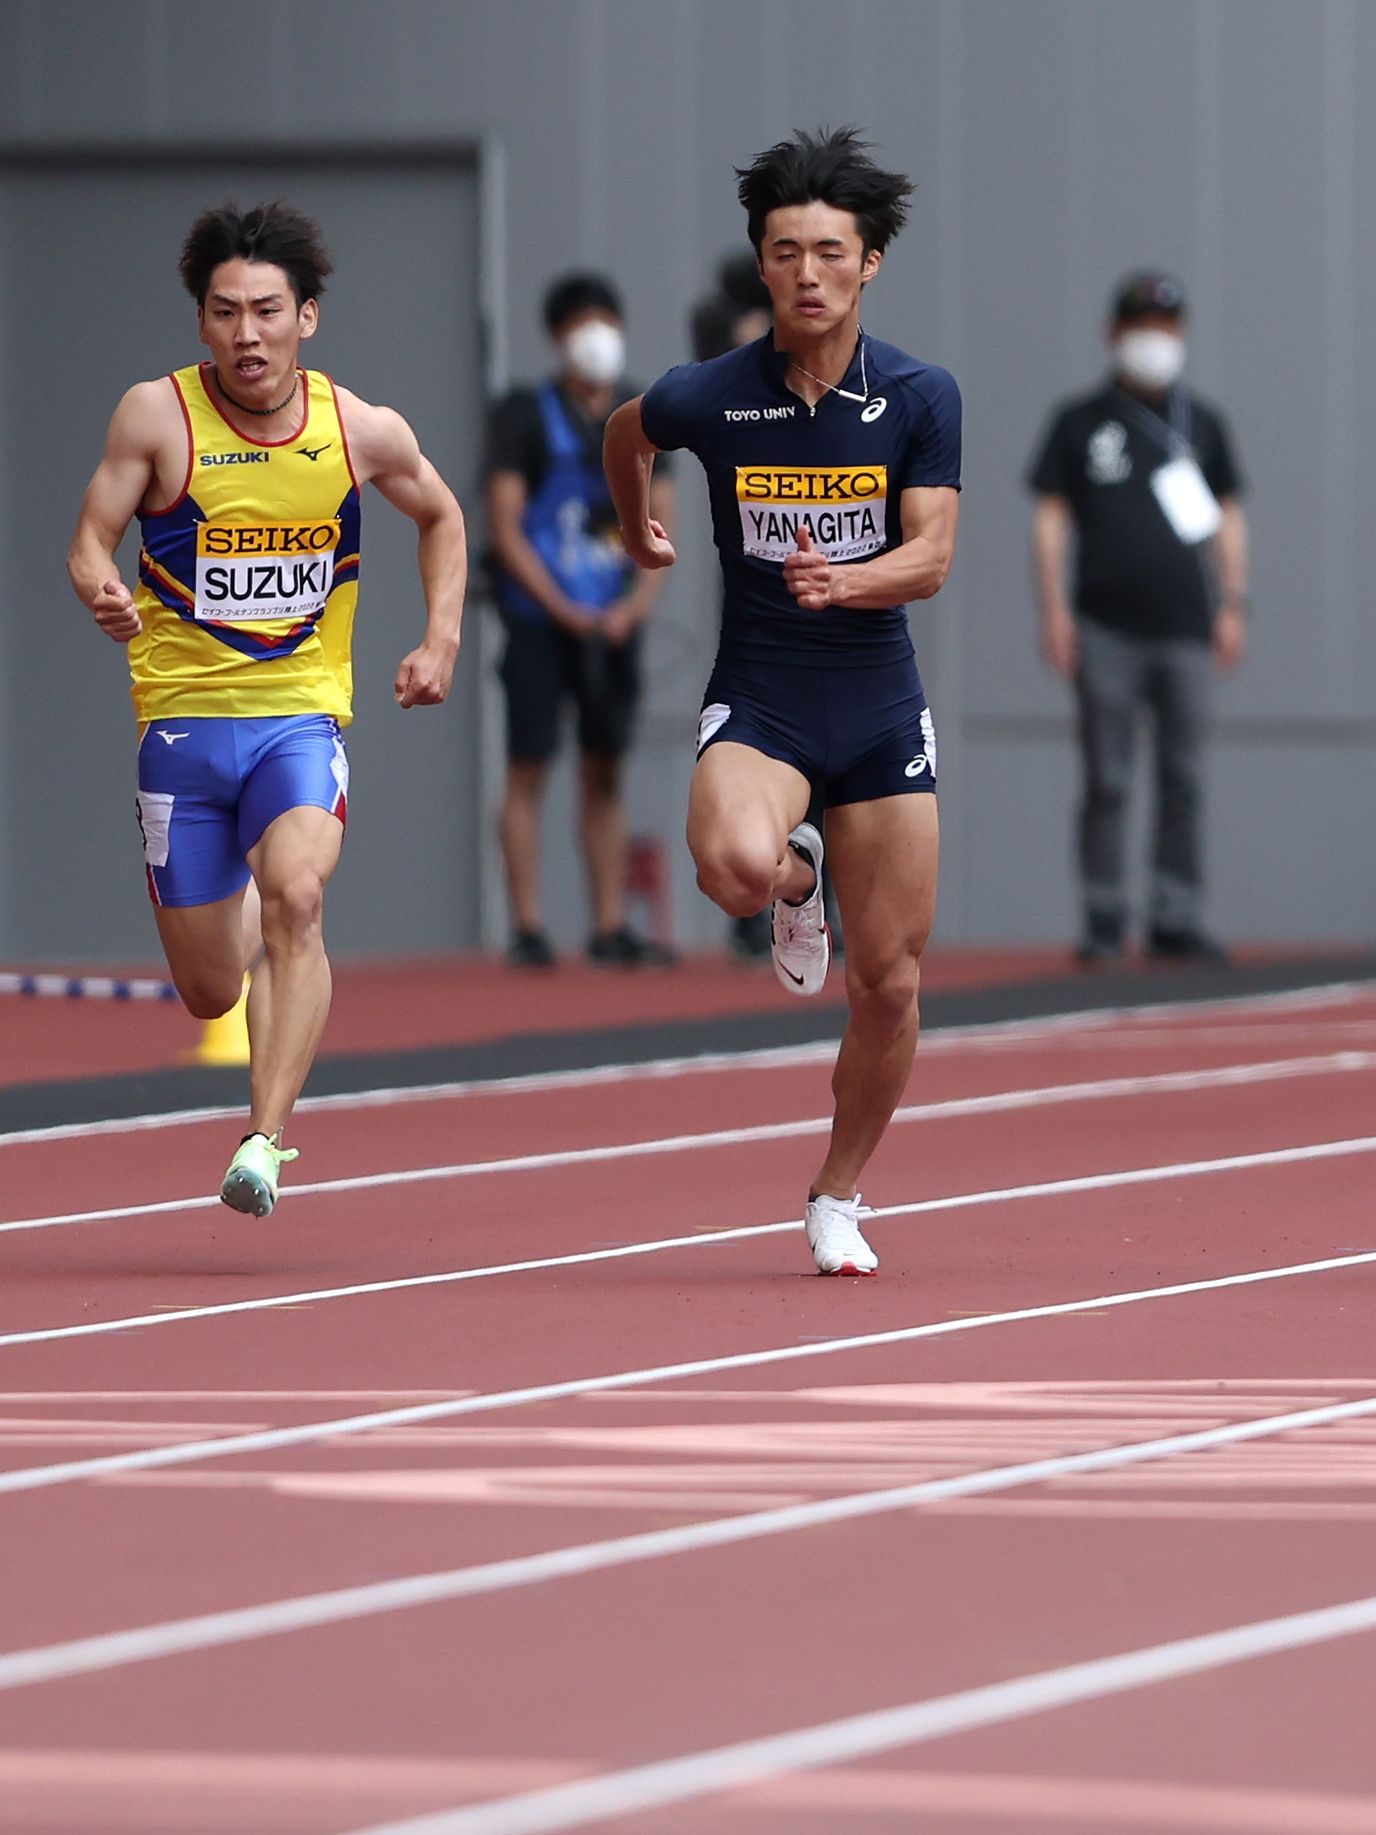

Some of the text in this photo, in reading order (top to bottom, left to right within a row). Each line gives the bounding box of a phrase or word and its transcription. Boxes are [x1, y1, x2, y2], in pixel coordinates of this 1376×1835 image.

[724, 405, 795, 422] TOYO UNIV
[200, 451, 270, 467] SUZUKI
[744, 472, 880, 500] SEIKO
[205, 525, 334, 554] SEIKO
[748, 507, 877, 545] YANAGITA
[204, 560, 327, 601] SUZUKI
